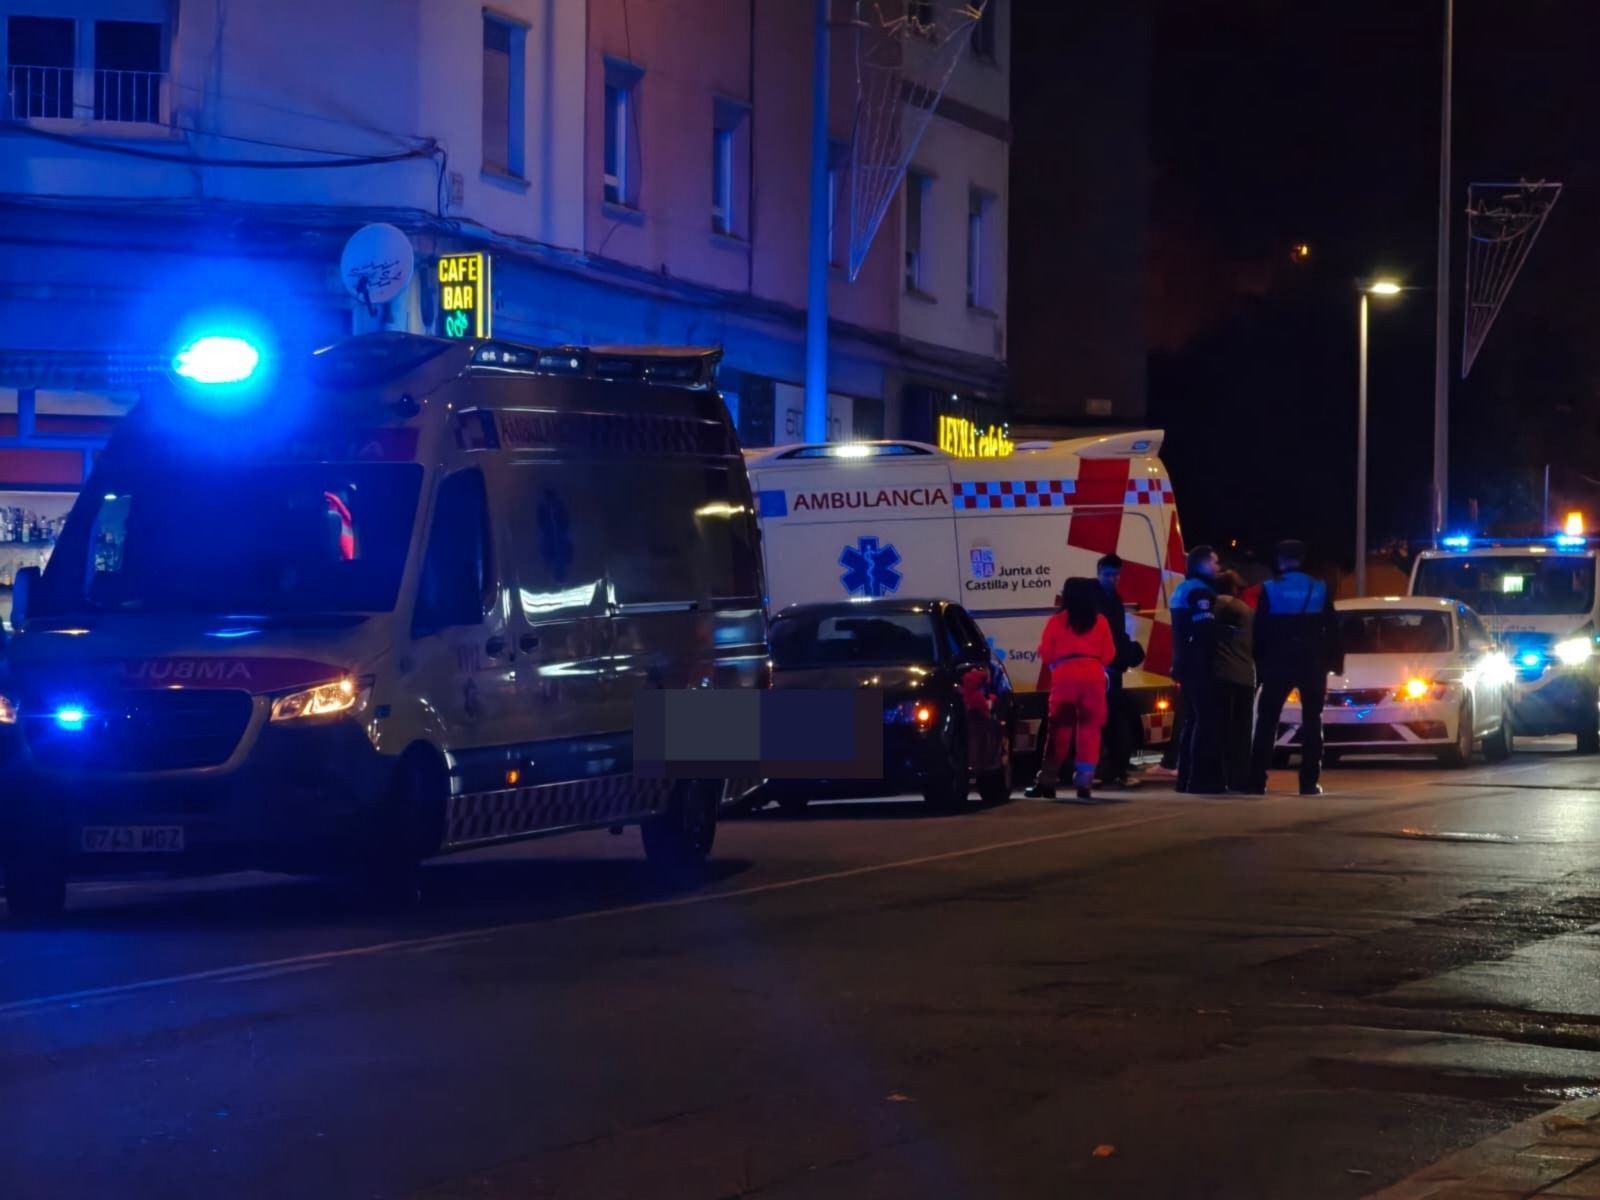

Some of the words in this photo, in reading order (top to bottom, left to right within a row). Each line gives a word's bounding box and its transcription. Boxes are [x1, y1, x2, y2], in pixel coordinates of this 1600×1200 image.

[439, 257, 478, 282] CAFE
[443, 284, 474, 311] BAR
[793, 488, 949, 511] AMBULANCIA
[999, 566, 1032, 577] Junta
[1035, 564, 1051, 576] de
[965, 579, 1009, 591] Castilla
[1011, 581, 1019, 592] y
[1022, 577, 1052, 589] León
[1009, 649, 1038, 662] Sacy
